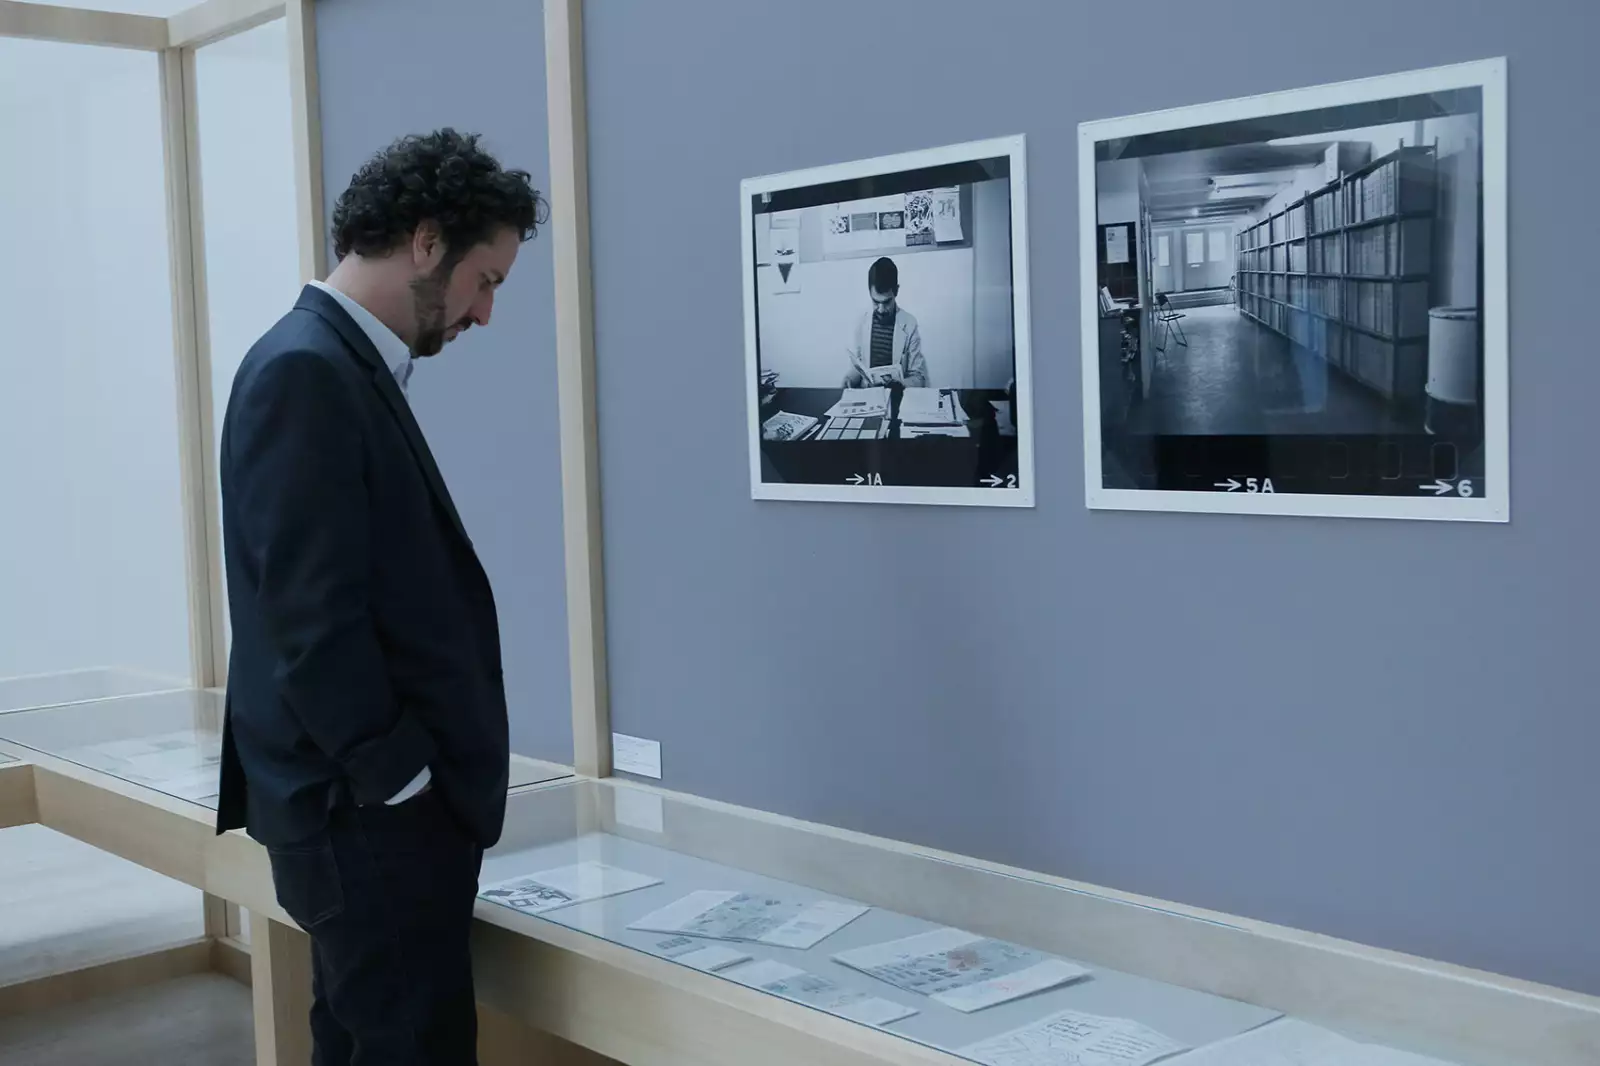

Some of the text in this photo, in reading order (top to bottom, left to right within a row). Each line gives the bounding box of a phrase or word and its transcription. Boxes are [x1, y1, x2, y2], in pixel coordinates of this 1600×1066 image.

[867, 472, 1017, 488] 1A 2
[1246, 477, 1474, 498] 5A 6
